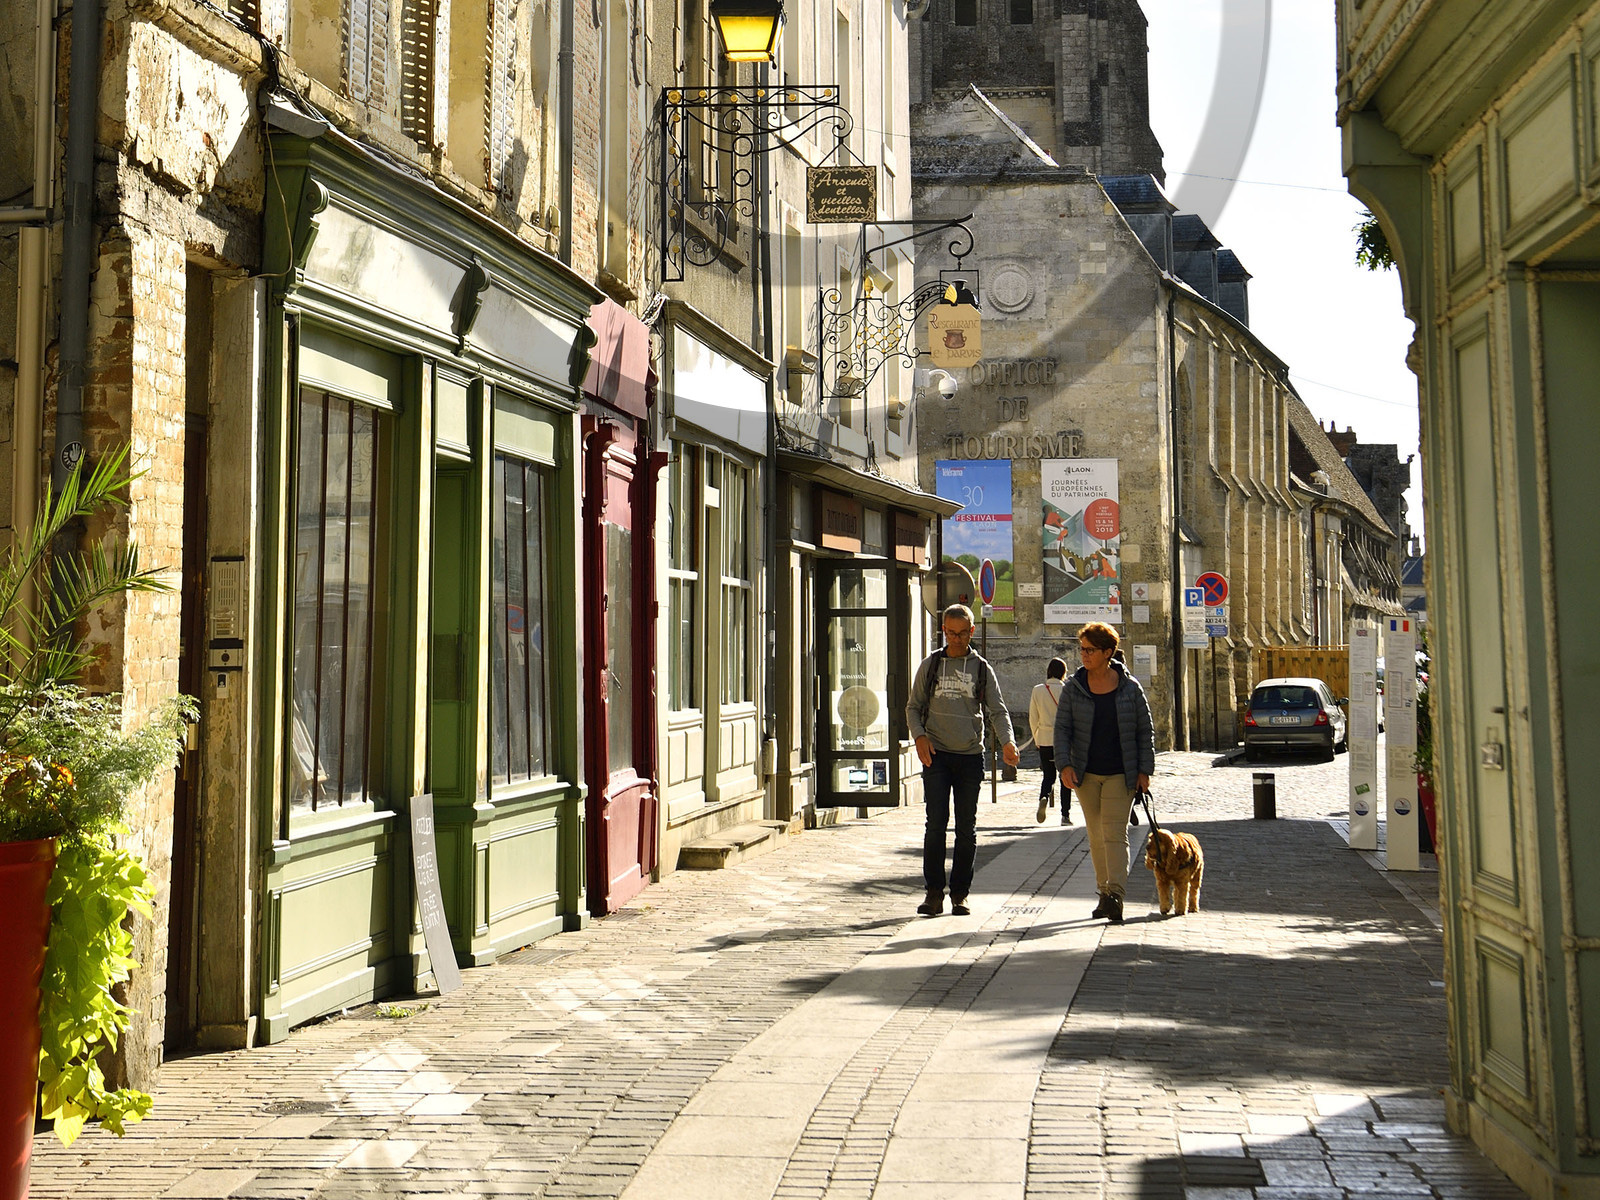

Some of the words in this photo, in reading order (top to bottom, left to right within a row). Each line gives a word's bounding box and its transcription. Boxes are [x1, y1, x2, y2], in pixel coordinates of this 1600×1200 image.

[816, 172, 868, 188] Arsenic
[836, 187, 847, 195] et
[821, 196, 862, 205] vieilles
[818, 205, 866, 214] dentelles
[968, 361, 1057, 386] OFFICE
[998, 397, 1029, 422] DE
[947, 434, 1083, 460] TOURISME
[956, 514, 997, 522] FESTIVAL
